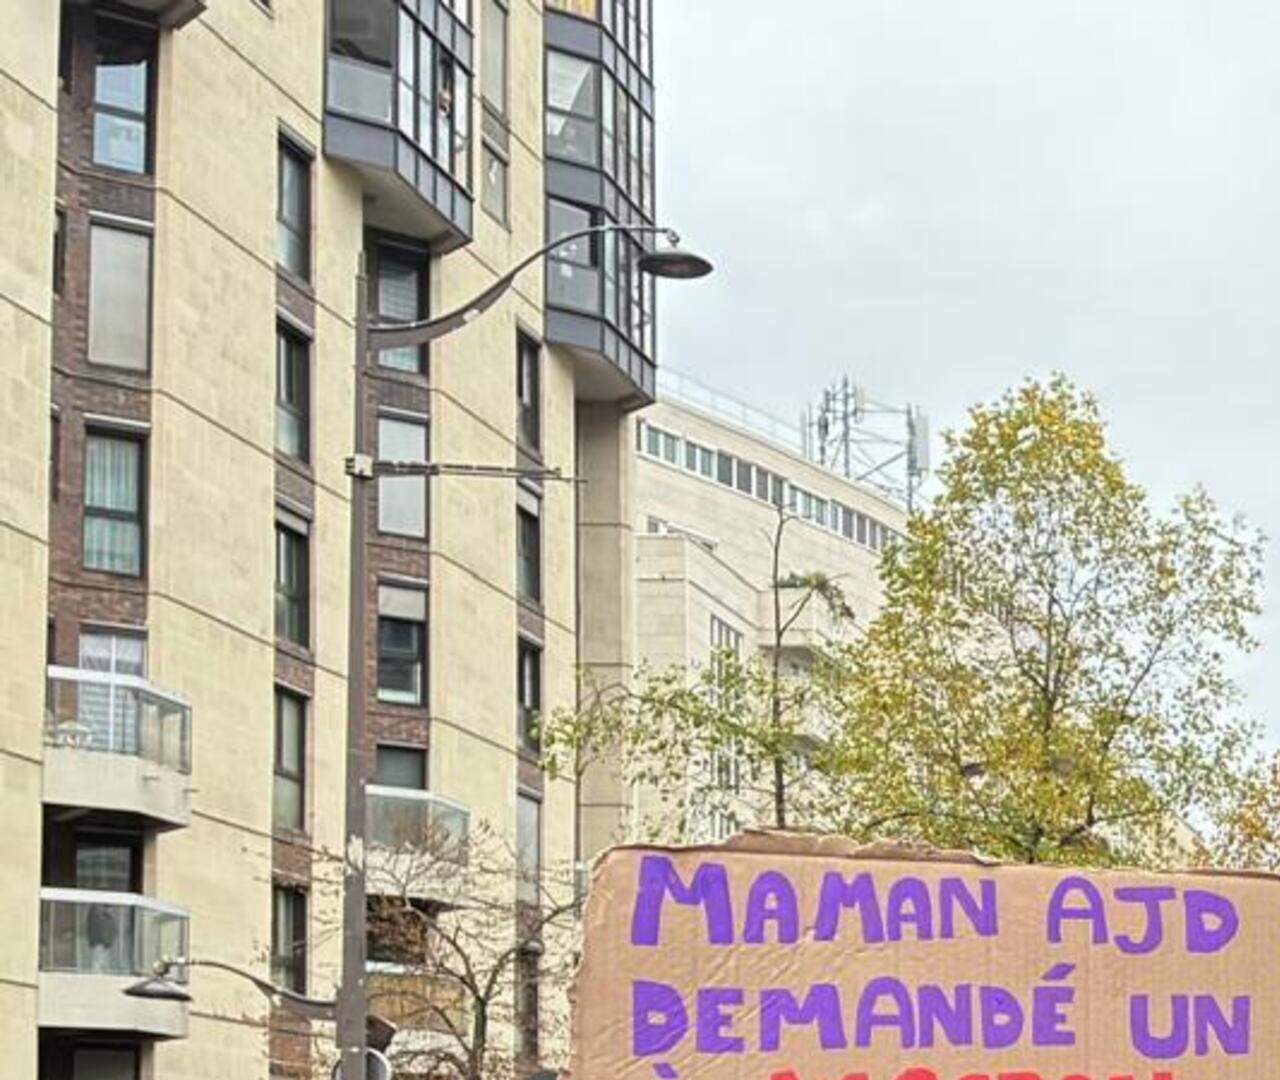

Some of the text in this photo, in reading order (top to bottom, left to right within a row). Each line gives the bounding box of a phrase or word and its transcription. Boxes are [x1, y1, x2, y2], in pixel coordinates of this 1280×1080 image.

[632, 856, 997, 947] MAMAN
[1047, 877, 1238, 954] AJD
[633, 965, 1075, 1056] DEMANDÉ
[1130, 997, 1251, 1058] UN
